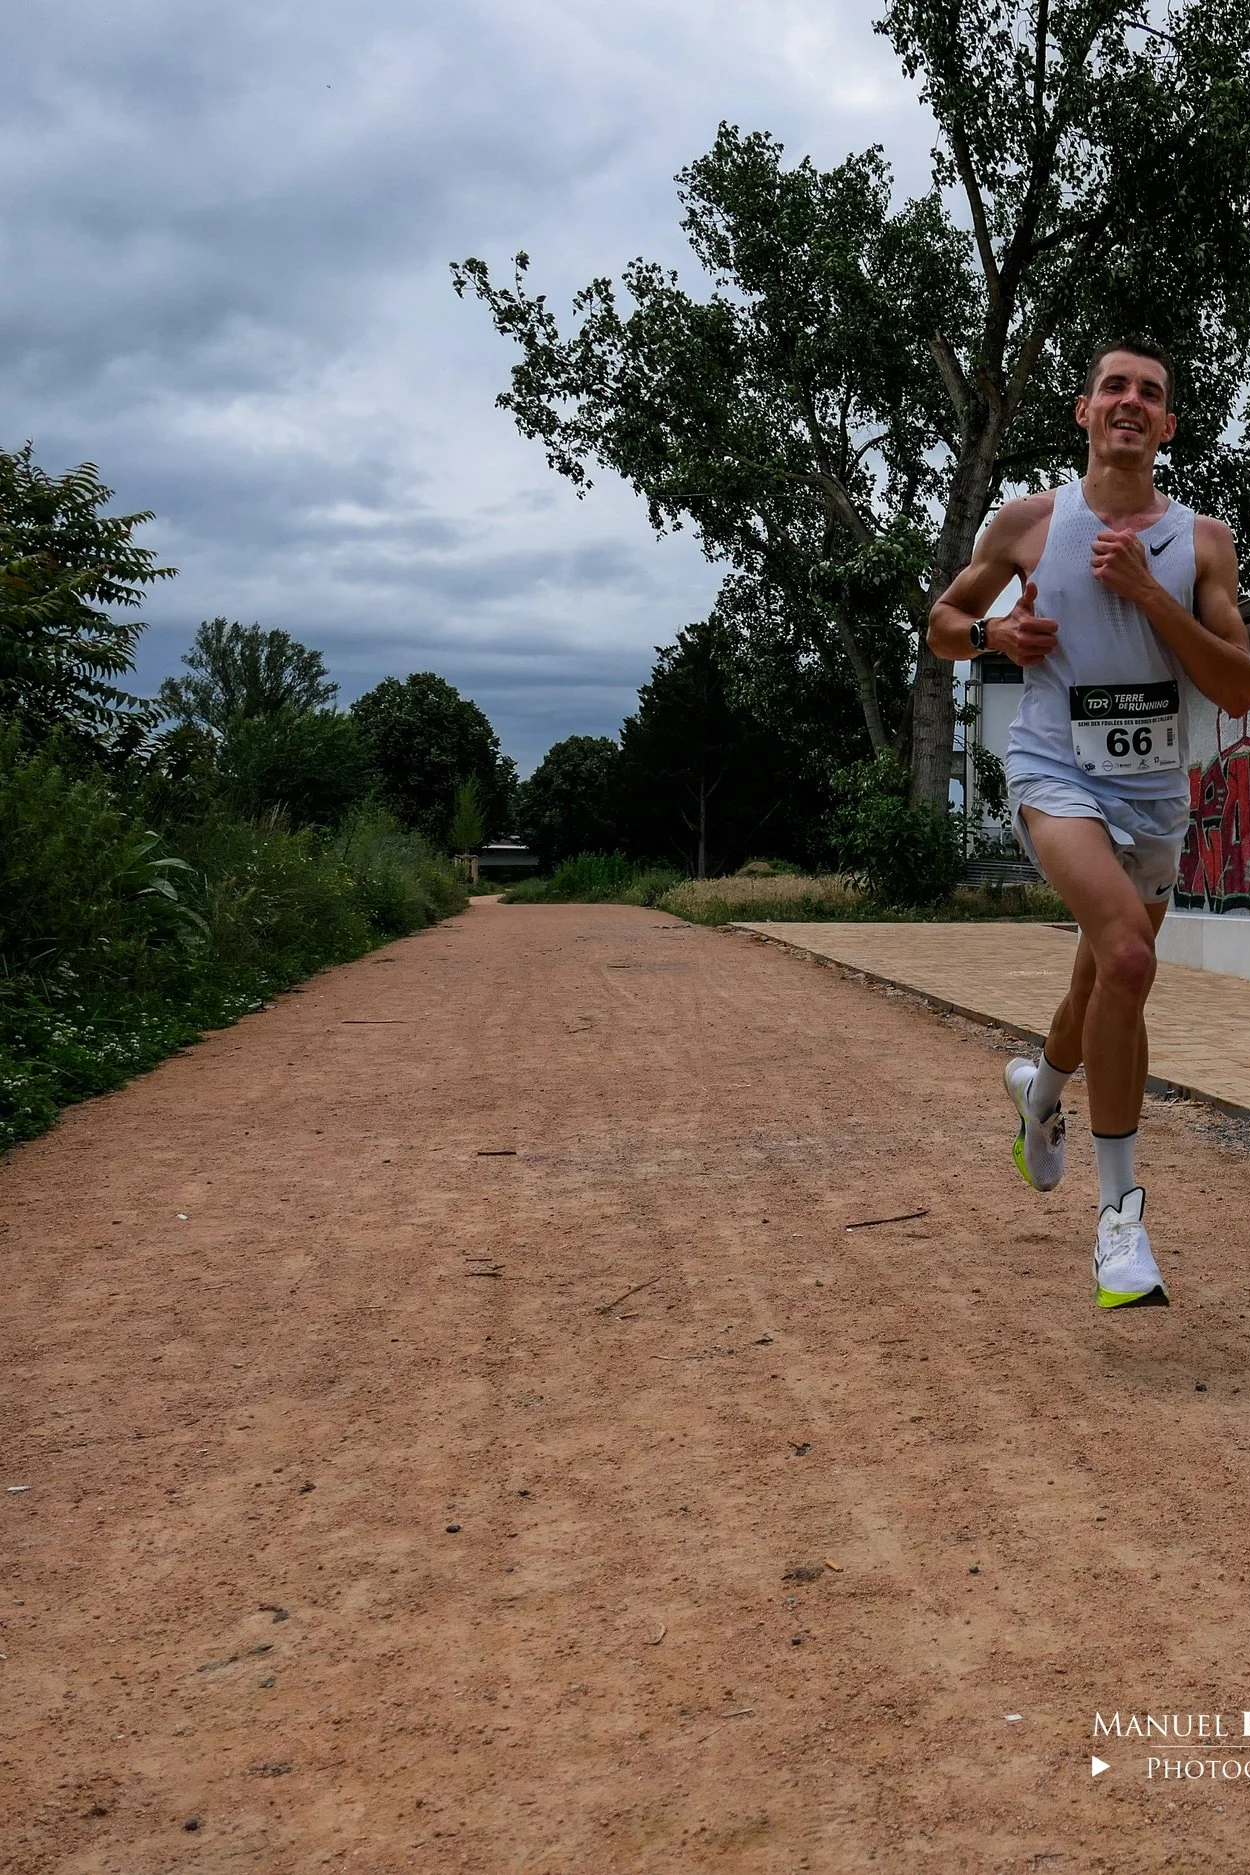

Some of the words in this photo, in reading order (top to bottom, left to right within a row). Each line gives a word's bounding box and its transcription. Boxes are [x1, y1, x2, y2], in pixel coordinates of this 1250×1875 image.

[1087, 698, 1109, 709] TDR
[1114, 693, 1144, 703] TERRE
[1118, 702, 1128, 710] DE
[1128, 700, 1169, 711] RUNNING
[1106, 727, 1153, 757] 66
